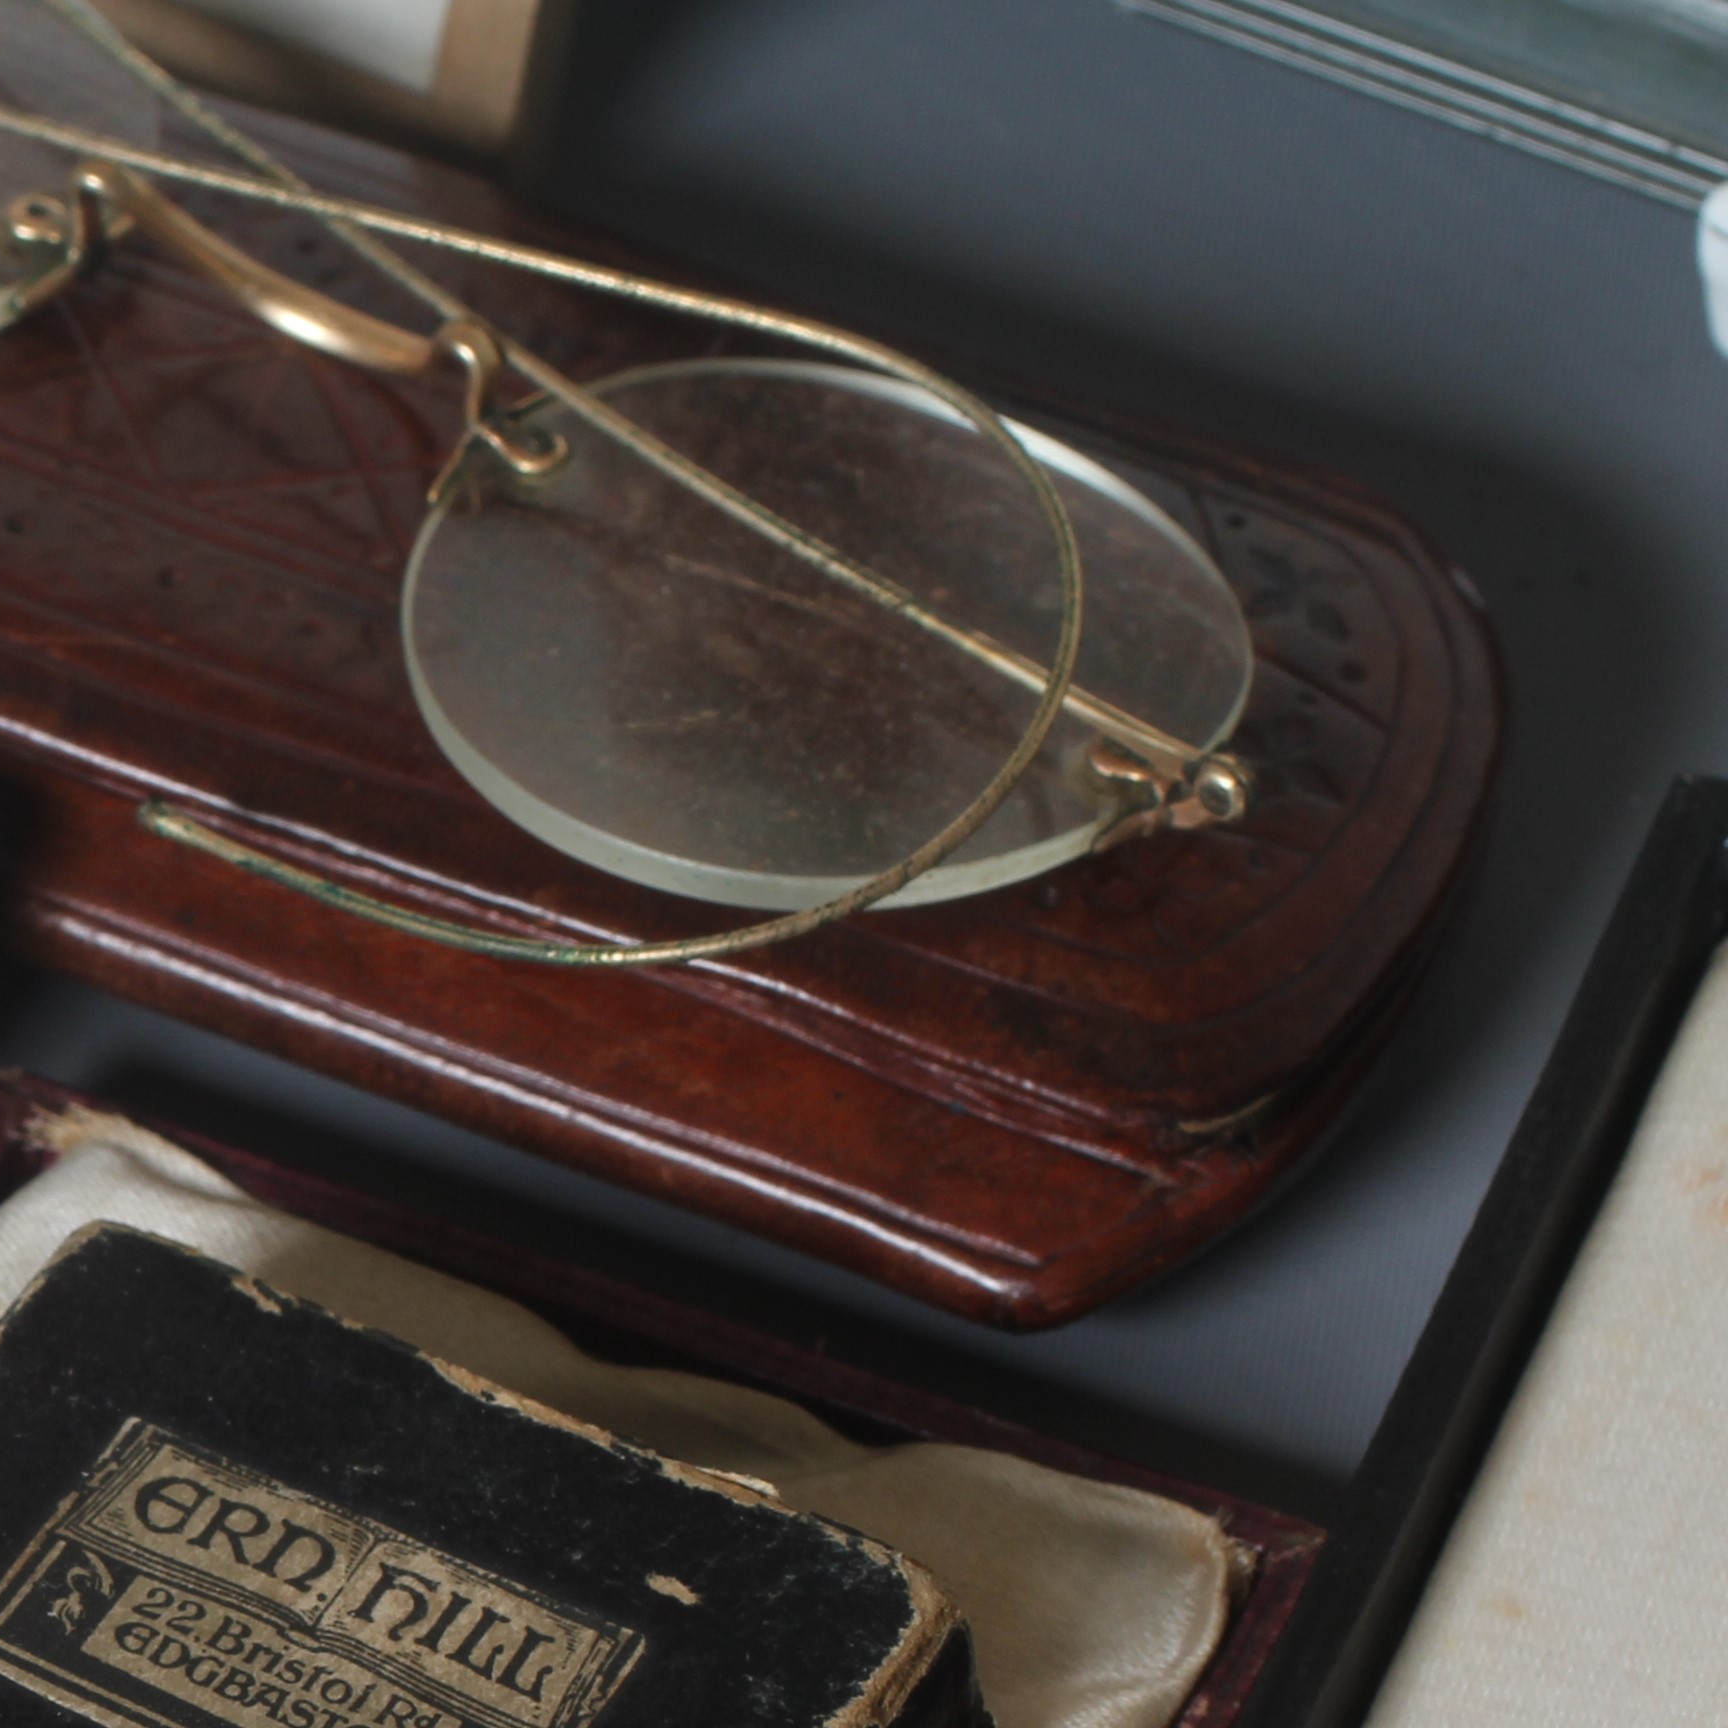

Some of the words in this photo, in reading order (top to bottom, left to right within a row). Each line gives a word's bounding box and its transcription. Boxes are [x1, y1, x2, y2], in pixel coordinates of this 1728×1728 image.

[134, 1475, 338, 1604] ERN.
[348, 1561, 555, 1704] HILL
[202, 1616, 374, 1716] Bristol
